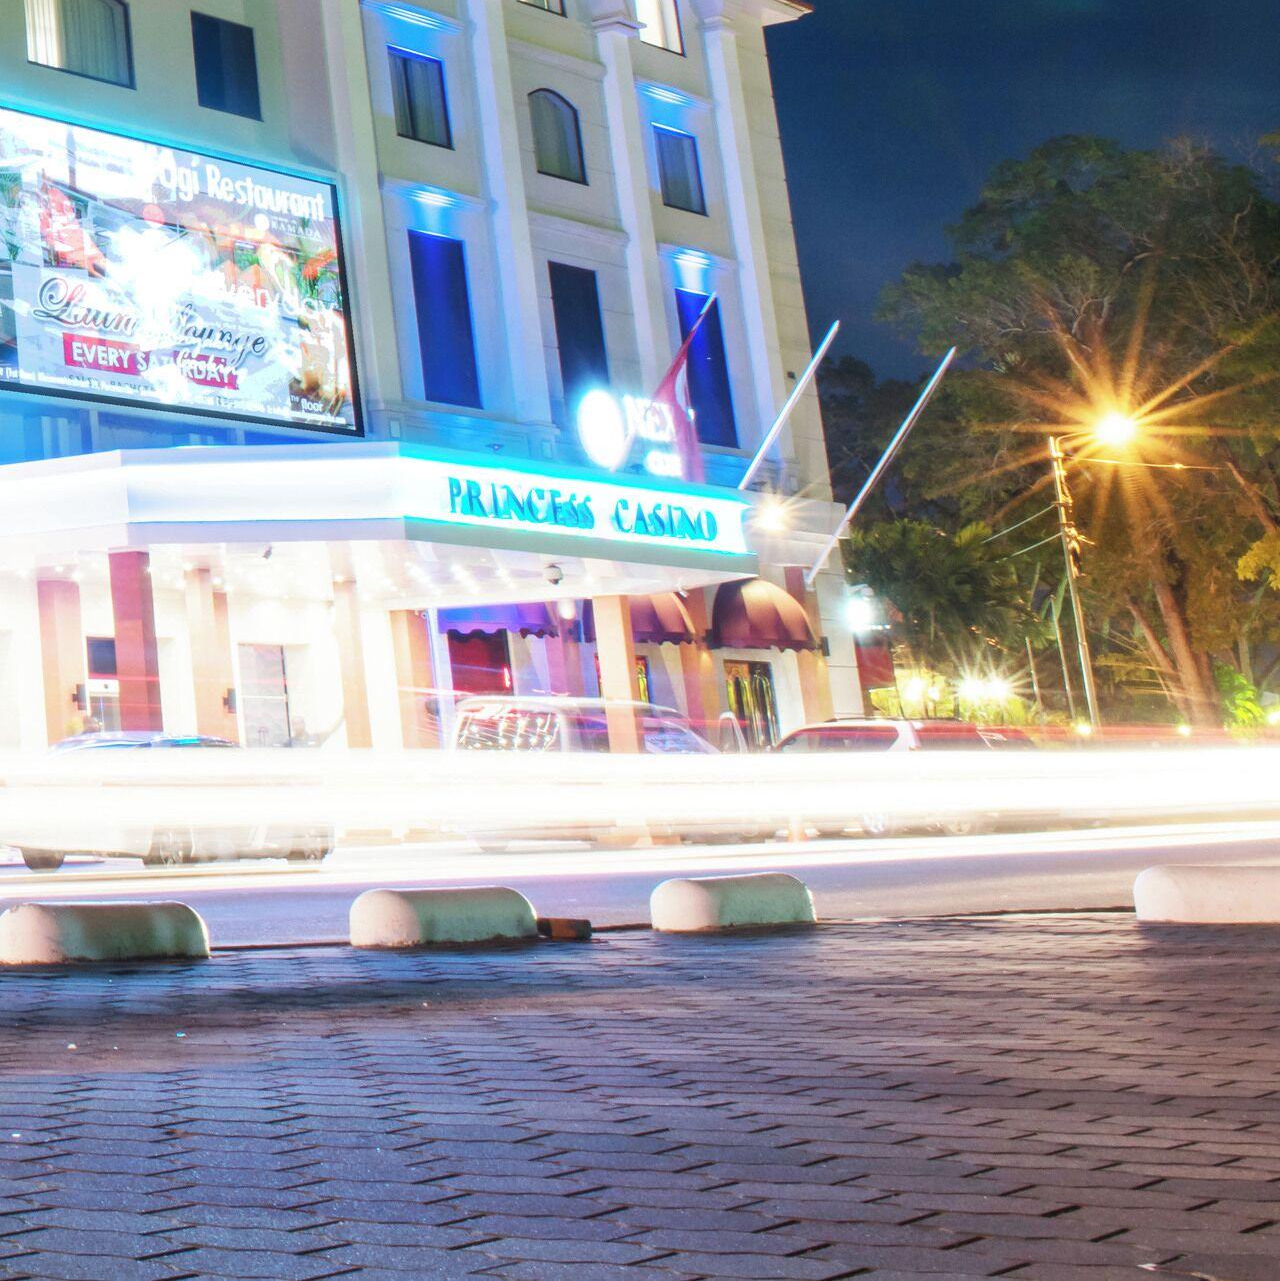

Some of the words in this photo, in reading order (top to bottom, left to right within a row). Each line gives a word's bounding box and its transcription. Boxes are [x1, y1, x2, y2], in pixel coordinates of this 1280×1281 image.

[205, 164, 324, 222] Restaurant
[271, 220, 322, 240] RAMADA
[72, 341, 131, 369] EVERY
[448, 477, 595, 530] PRINCESS
[613, 498, 718, 542] CASINO
